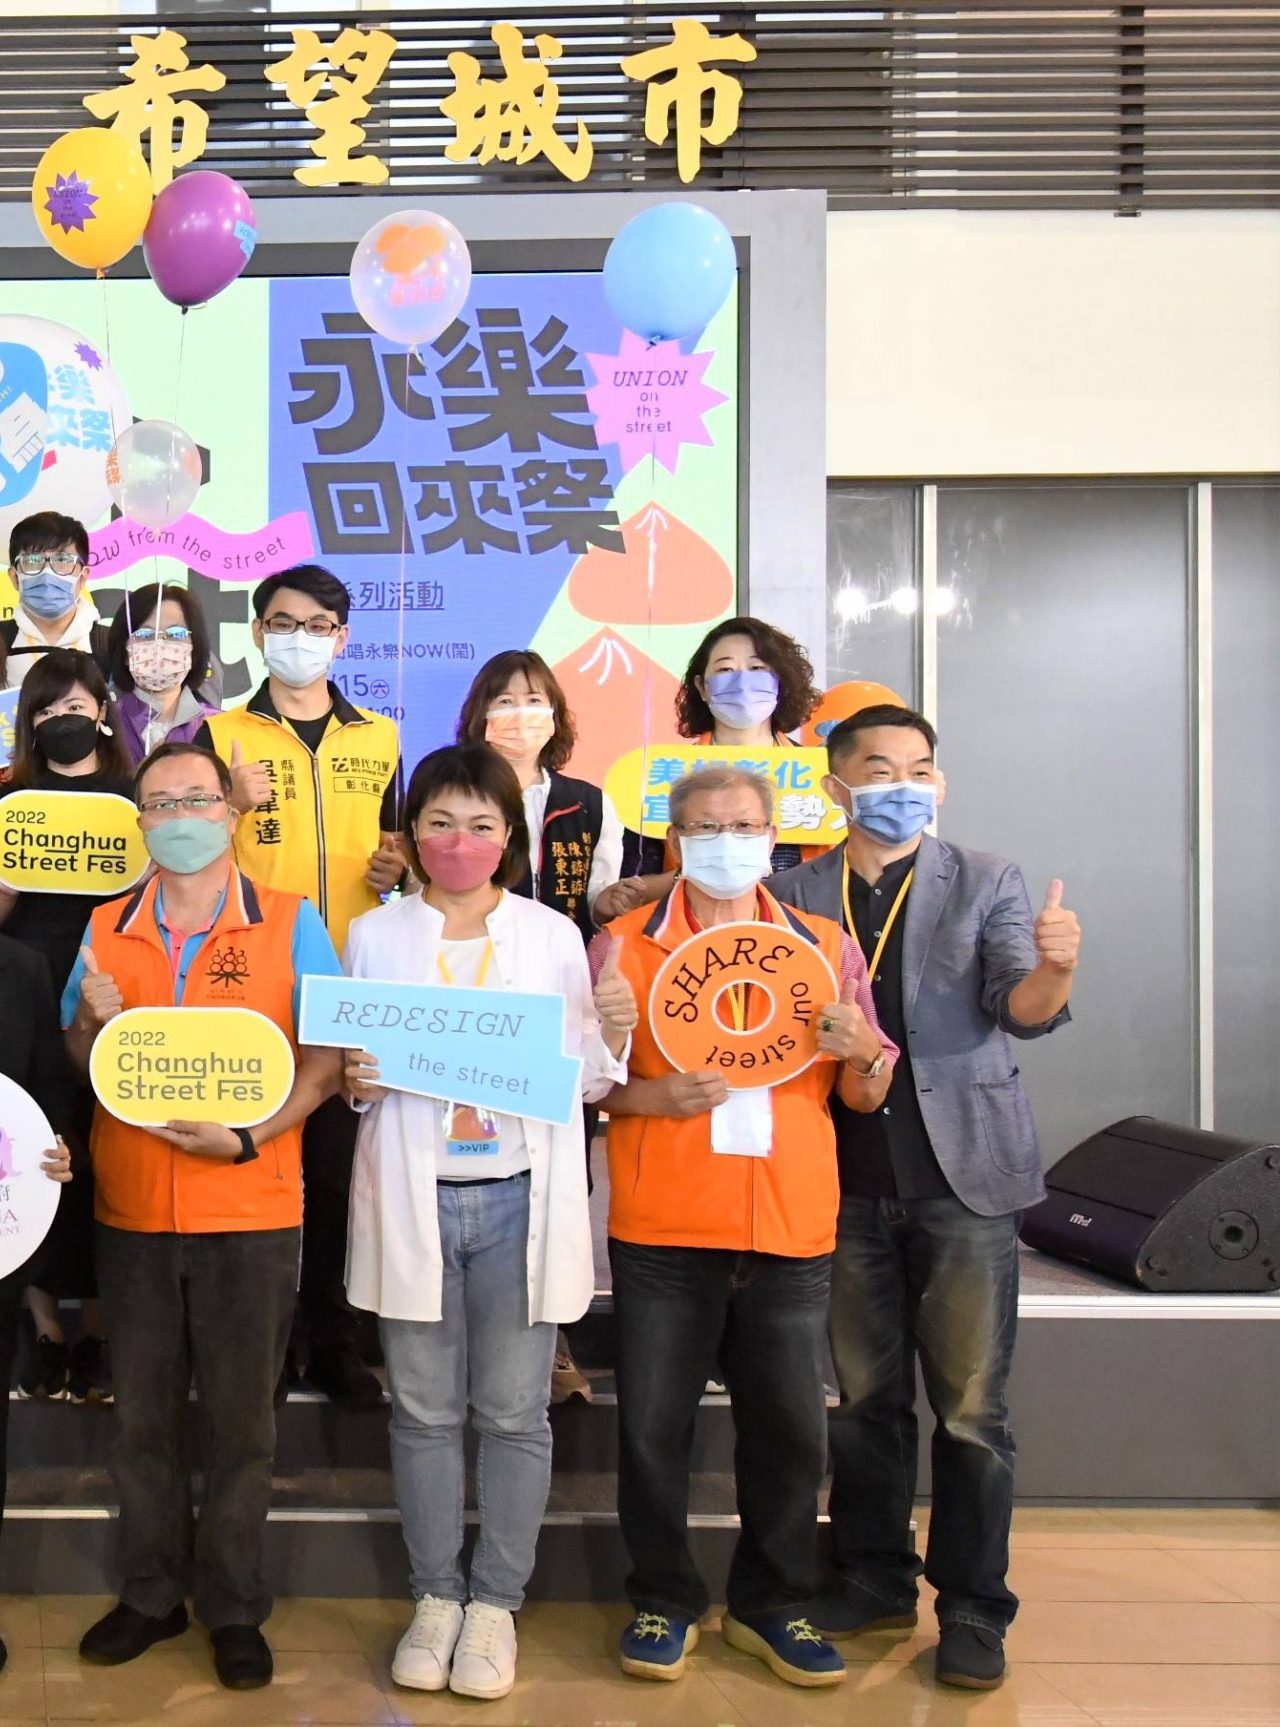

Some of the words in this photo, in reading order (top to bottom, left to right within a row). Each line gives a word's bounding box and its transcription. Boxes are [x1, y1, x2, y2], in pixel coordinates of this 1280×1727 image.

[82, 19, 758, 198] 希望城市
[288, 308, 600, 457] 永樂
[613, 370, 688, 387] UNION
[625, 420, 673, 434] street
[300, 458, 627, 555] 回來祭
[128, 526, 176, 548] from
[182, 534, 213, 563] the
[222, 535, 288, 570] street
[280, 759, 297, 801] 縣議員
[5, 810, 47, 825] 2022
[3, 828, 128, 854] Changhua
[2, 848, 79, 872] Street
[86, 853, 128, 875] Fes
[664, 937, 795, 1024] SHARE
[331, 1000, 526, 1038] REDESIGN
[790, 981, 813, 1028] our
[118, 1031, 166, 1046] 2022
[704, 1033, 797, 1069] street
[117, 1050, 263, 1079] Changhua
[408, 1052, 447, 1077] the
[456, 1065, 532, 1096] street
[116, 1074, 207, 1101] Street
[216, 1079, 265, 1102] Fes
